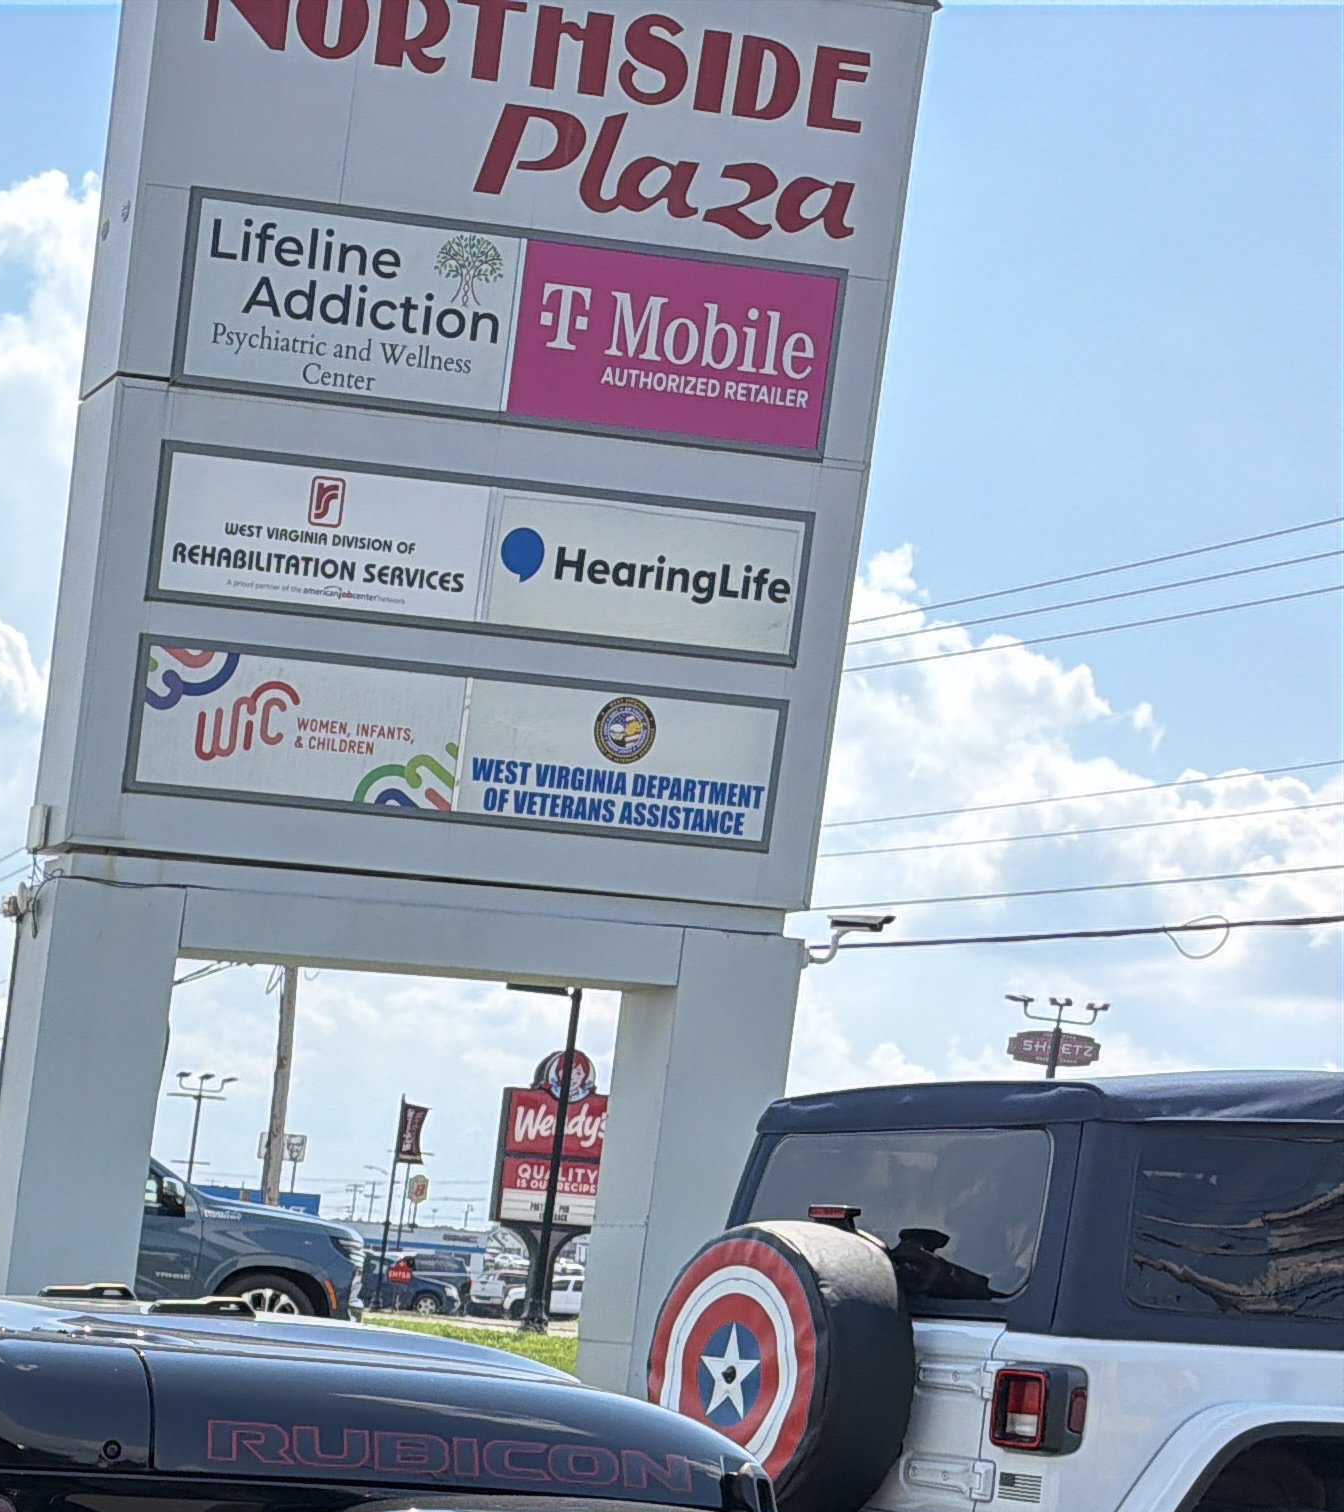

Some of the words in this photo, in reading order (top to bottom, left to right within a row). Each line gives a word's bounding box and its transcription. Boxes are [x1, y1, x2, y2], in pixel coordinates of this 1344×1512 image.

[204, 0, 871, 133] NORTHSIDE
[473, 103, 855, 239] Plaza
[210, 218, 401, 279] Lifeline
[242, 276, 499, 343] Addiction
[604, 290, 815, 380] Mobile
[211, 322, 327, 355] Psychiatric
[333, 339, 372, 362] and
[379, 342, 472, 374] Wellness
[302, 362, 376, 391] Center
[600, 366, 720, 399] AUTHORIZED
[724, 381, 809, 409] RETAILER
[225, 522, 262, 538] WEST
[266, 526, 328, 546] VIRGINIA
[332, 534, 392, 553] DIVISION
[396, 542, 416, 555] OF
[172, 542, 356, 582] REHABILITATION
[363, 563, 464, 593] SERVICES
[554, 545, 790, 604] HearingLife
[295, 736, 304, 749] &
[308, 736, 375, 756] CHILDREN
[297, 717, 351, 737] WOMEN,
[356, 723, 415, 745] INFANTS,
[472, 757, 532, 785] WEST
[535, 763, 627, 795] VIRGINIA
[631, 773, 765, 809] DEPARTMENT
[483, 787, 509, 812] OF
[513, 790, 615, 824] VETERANS
[619, 801, 746, 836] ASSISTANCE
[207, 1419, 692, 1493] RUBICON
